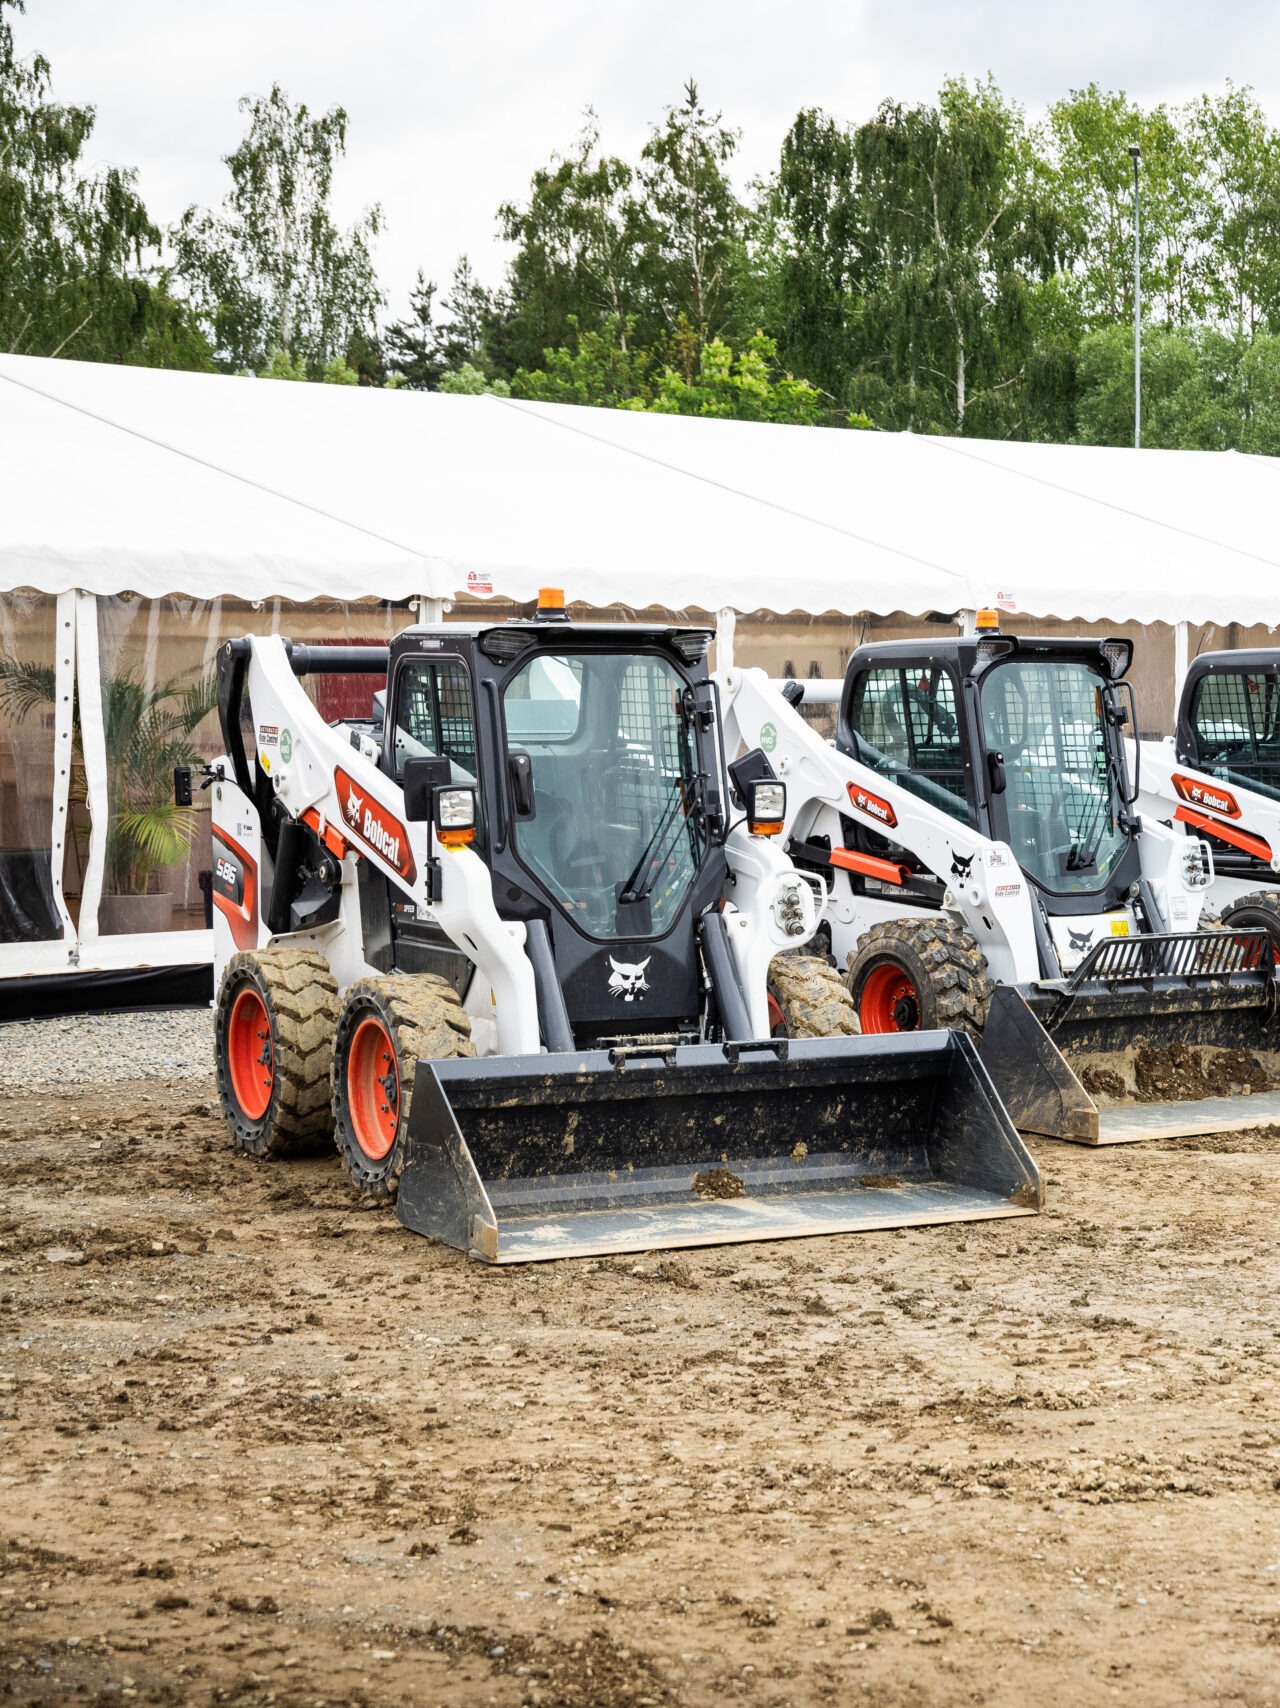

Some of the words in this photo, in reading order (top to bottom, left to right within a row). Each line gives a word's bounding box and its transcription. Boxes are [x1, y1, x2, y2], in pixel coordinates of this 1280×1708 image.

[867, 799, 888, 821] Bobcat
[1203, 792, 1229, 812] Bobcat
[363, 807, 400, 868] Bobcat
[216, 858, 237, 885] S86
